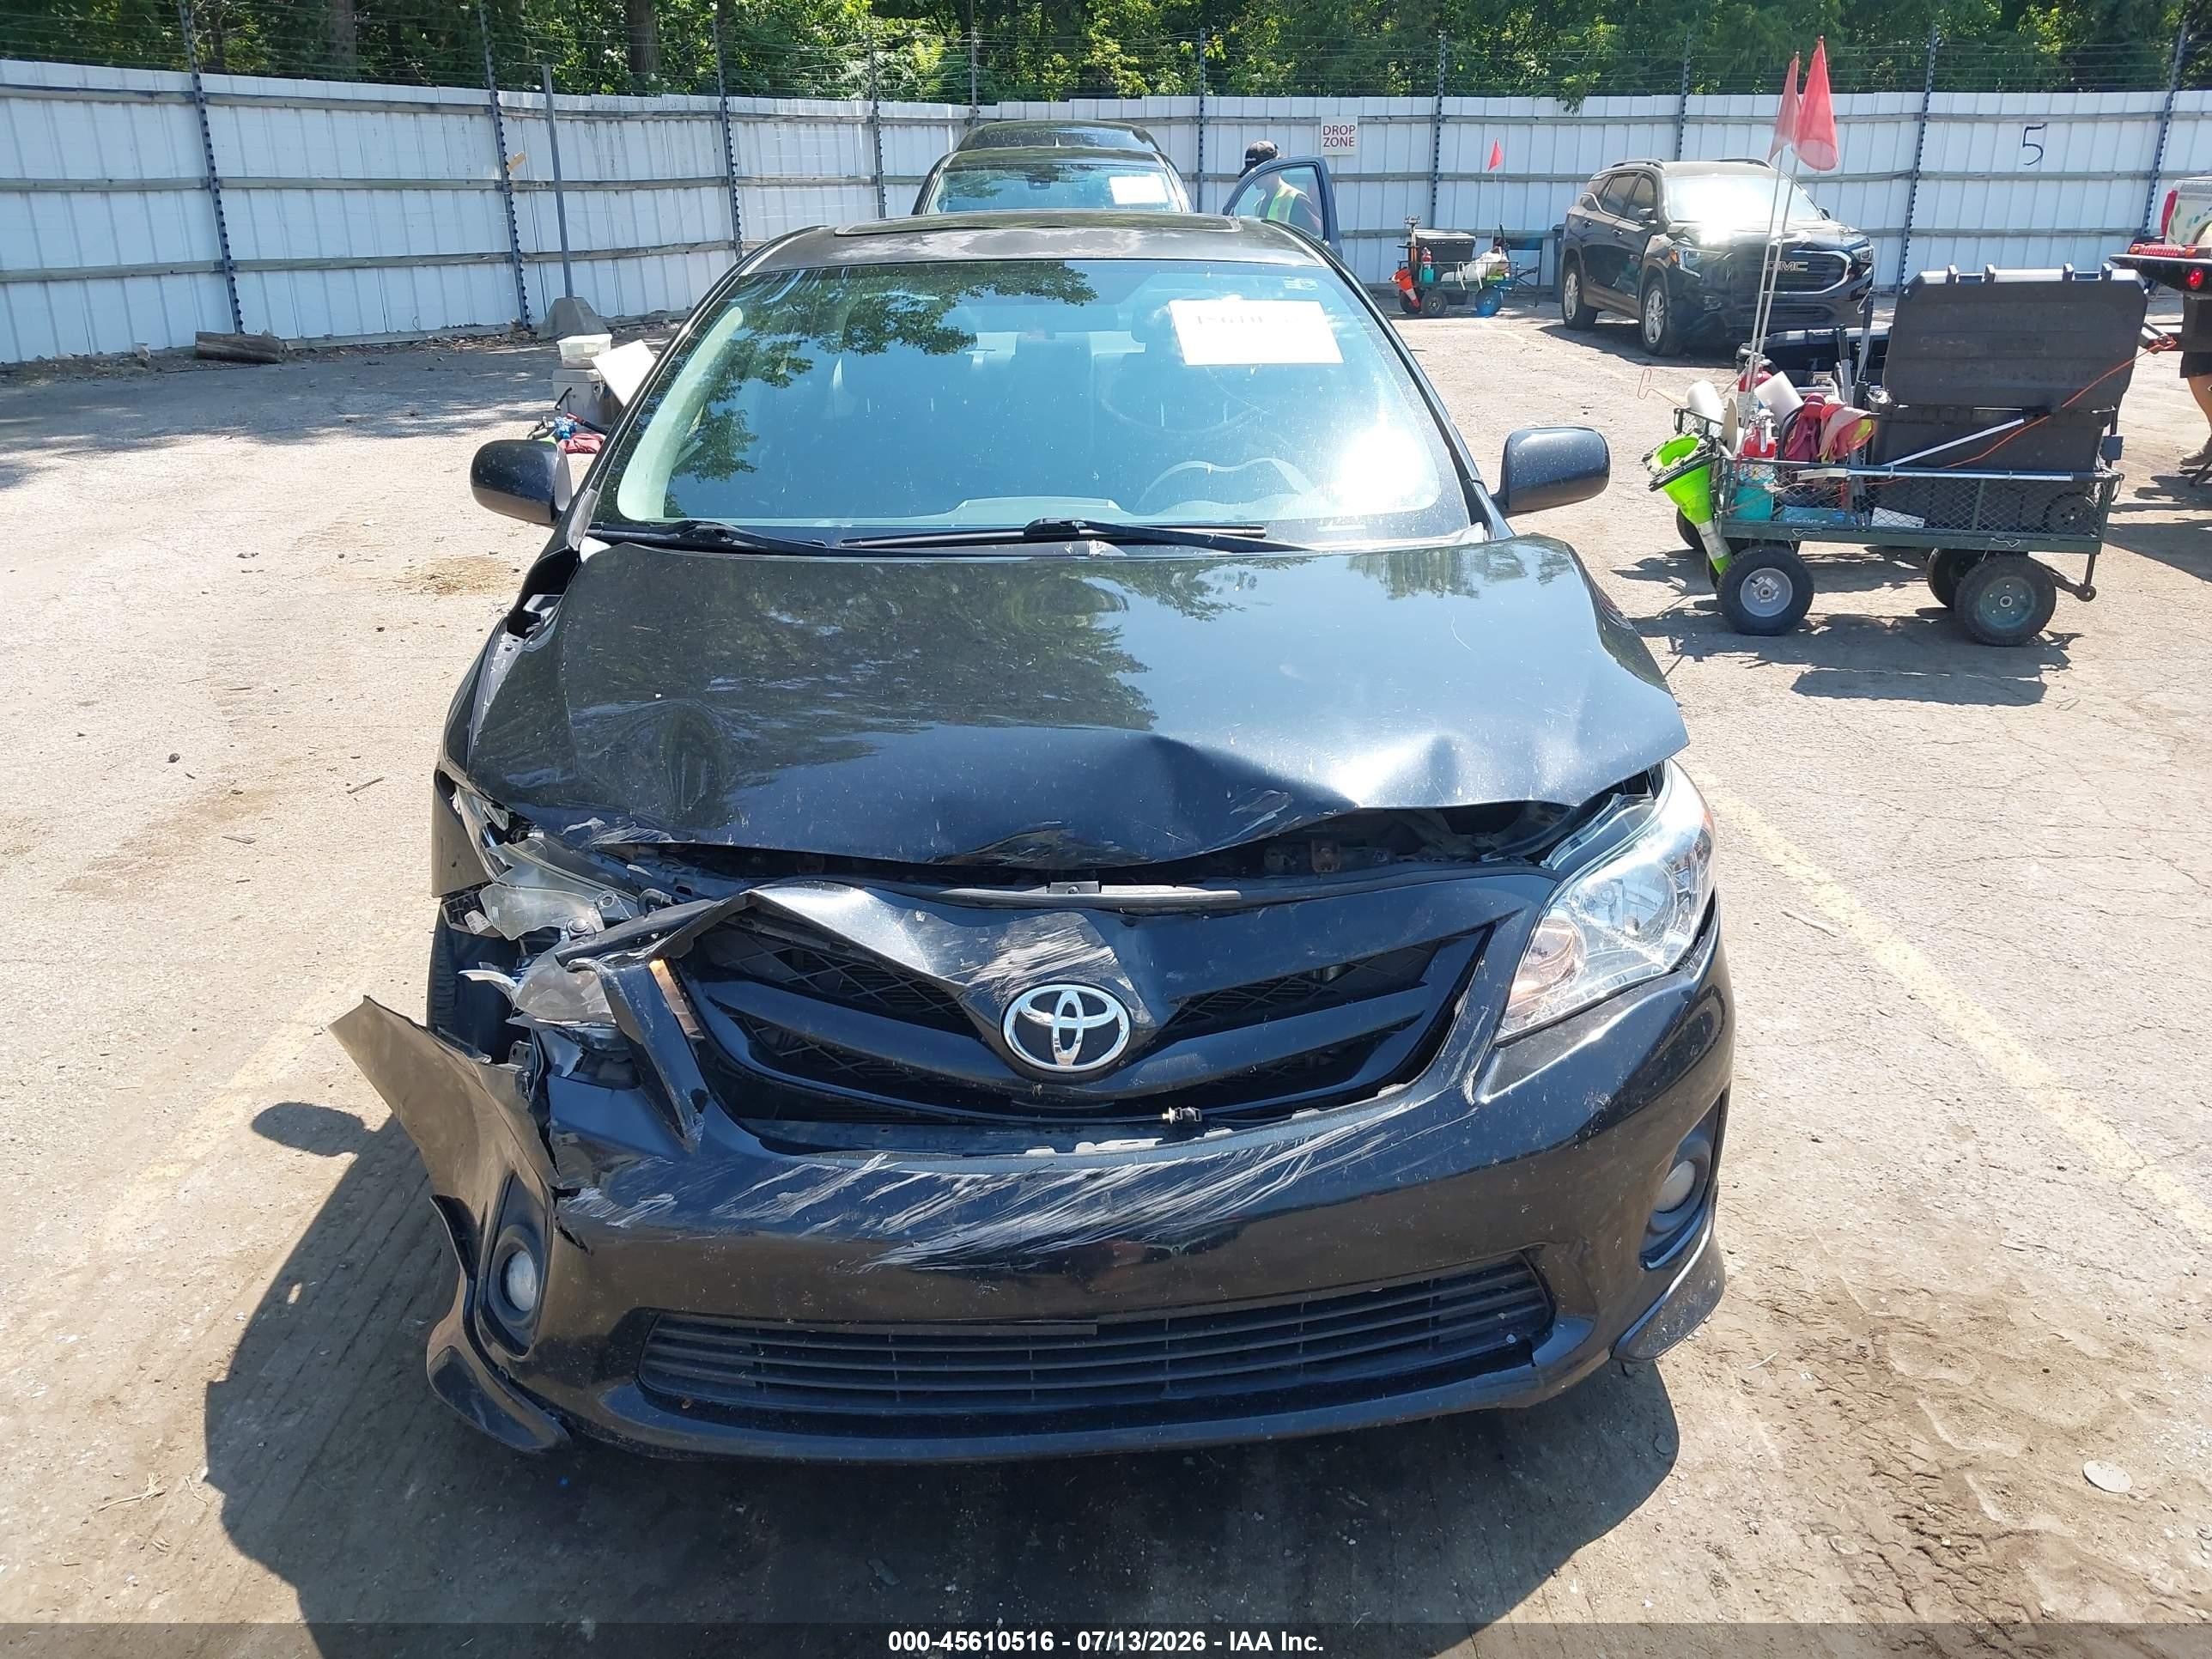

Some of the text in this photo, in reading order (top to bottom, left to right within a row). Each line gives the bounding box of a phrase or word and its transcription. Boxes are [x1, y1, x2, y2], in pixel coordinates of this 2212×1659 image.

[1323, 125, 1356, 136] DROP
[1323, 137, 1355, 147] ZONE
[2022, 123, 2047, 166] 5
